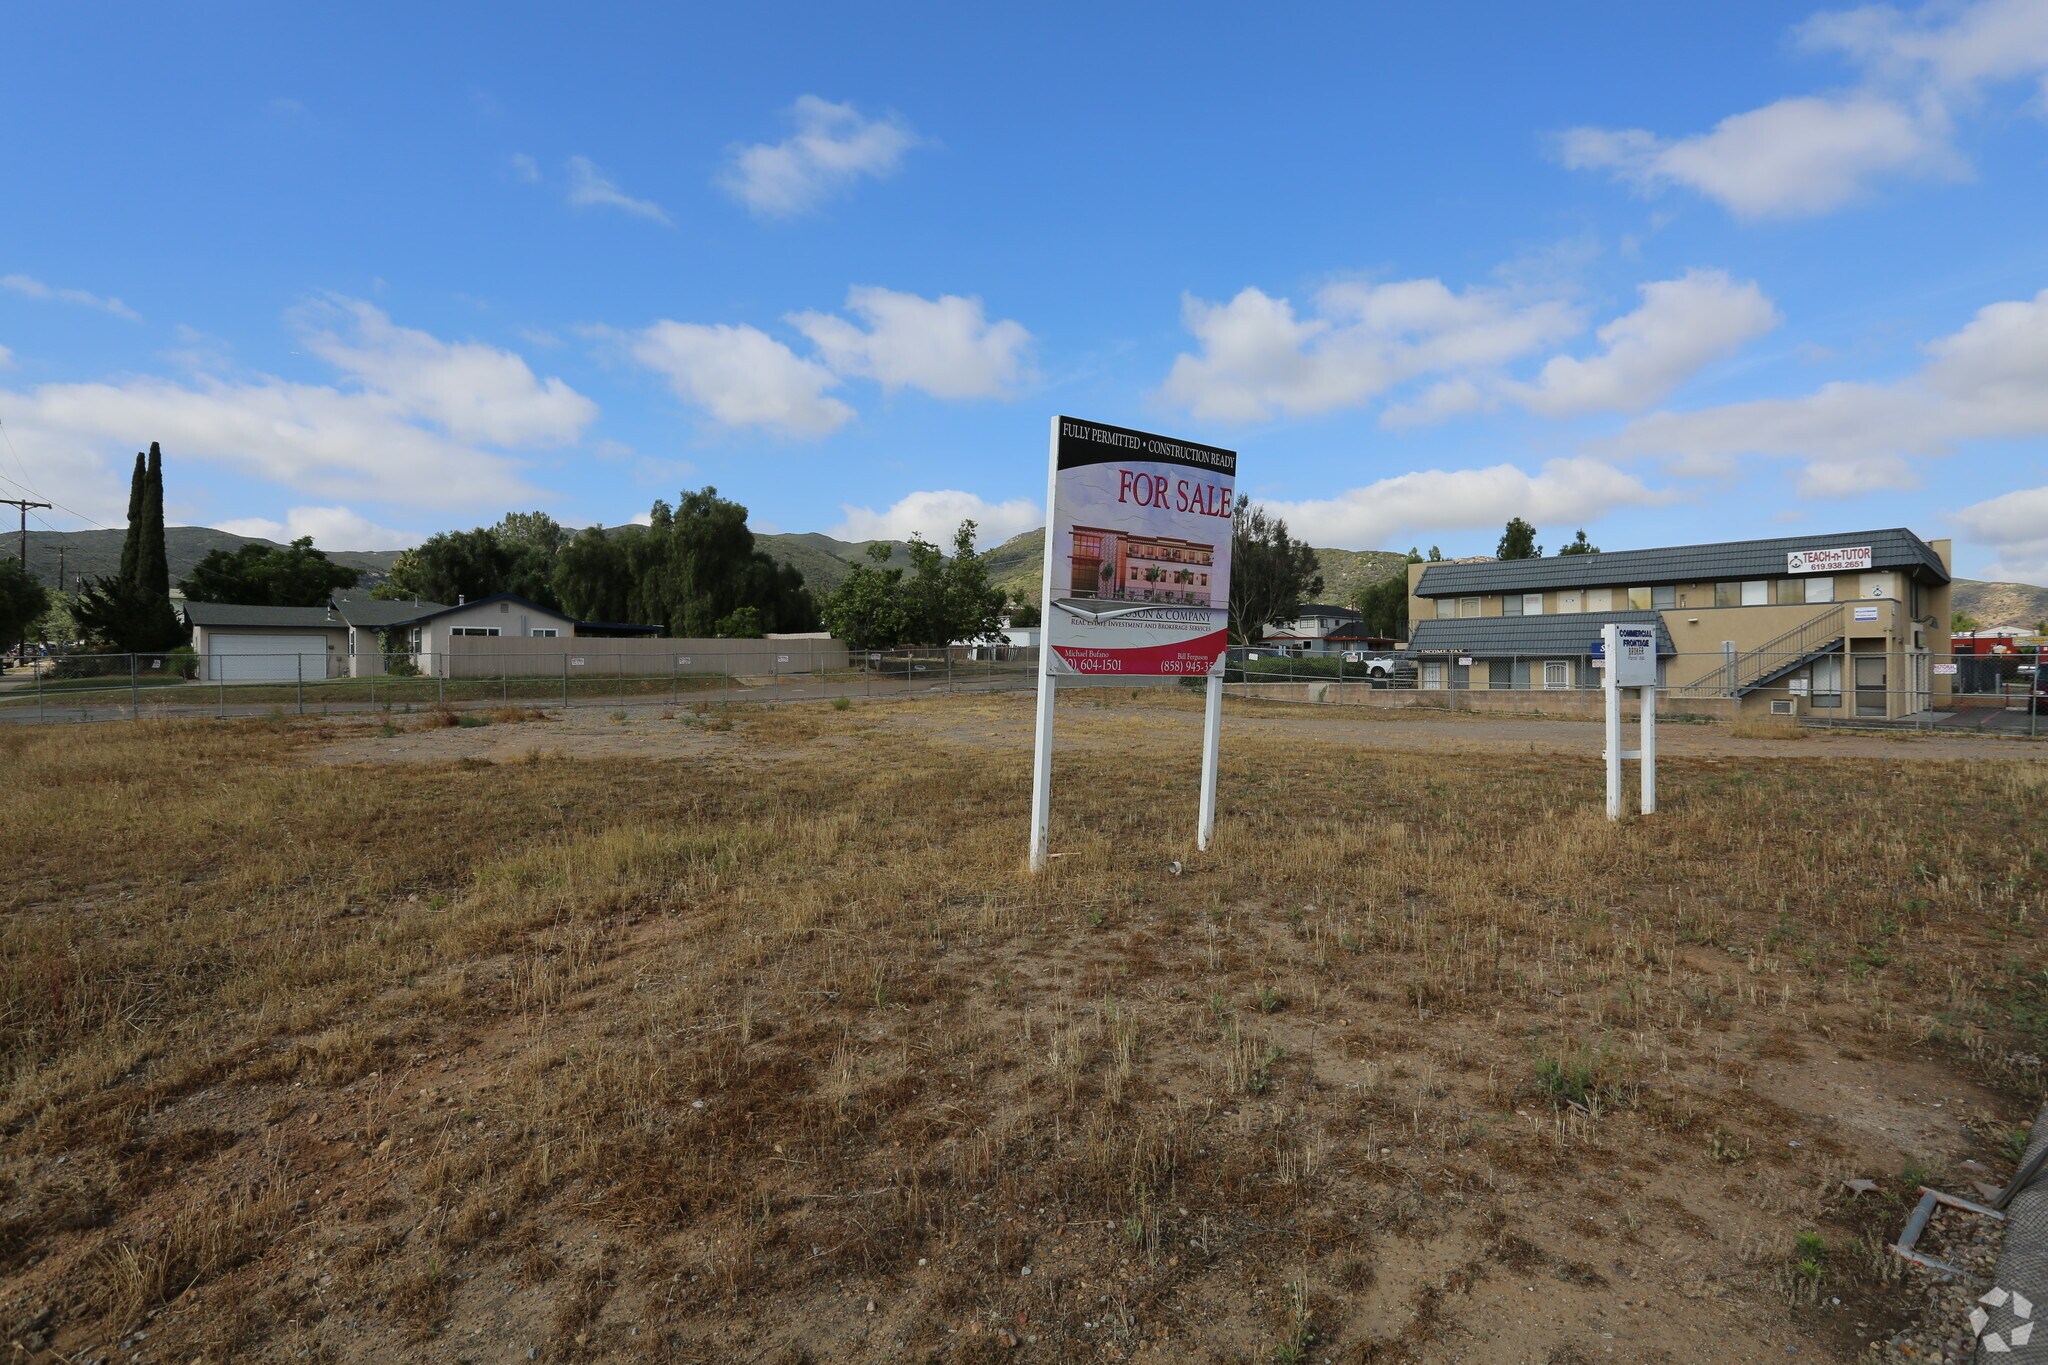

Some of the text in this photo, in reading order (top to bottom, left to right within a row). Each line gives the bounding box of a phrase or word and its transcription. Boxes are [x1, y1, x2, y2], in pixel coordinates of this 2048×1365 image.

[1063, 422, 1236, 469] FULLY PERMITTED CONSTRUCTION READY
[1118, 469, 1232, 518] FOR SALE
[1803, 548, 1870, 563] TEACH-n-TUTOR
[1811, 561, 1864, 571] 619.938.2651
[1071, 618, 1086, 626] REAL
[1155, 610, 1164, 619] &
[1165, 610, 1211, 623] COMPANY
[1619, 629, 1652, 637] COMMERCIAL
[1623, 639, 1649, 647] FRONTAGE
[1065, 649, 1088, 657] Michael
[1177, 652, 1208, 662] Bill Ferguson
[1080, 658, 1122, 671] 604-1501
[1160, 660, 1184, 673] (858)
